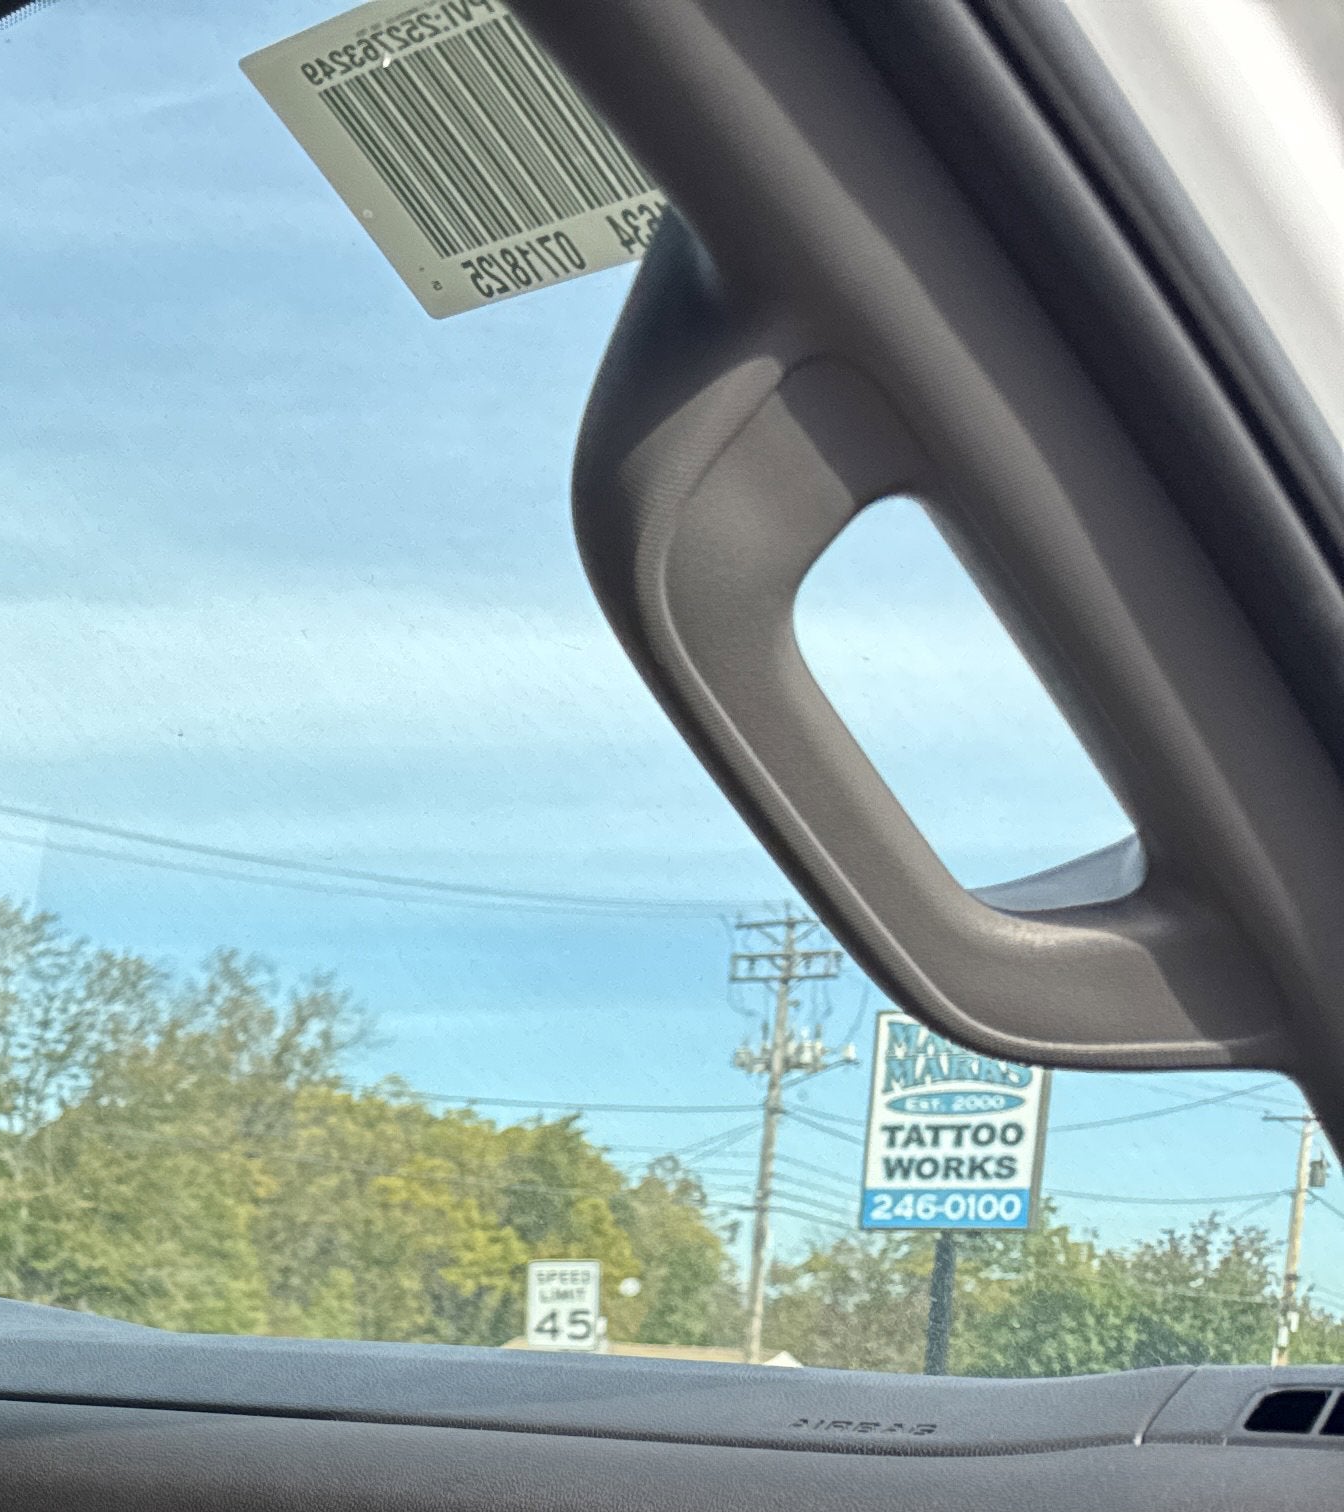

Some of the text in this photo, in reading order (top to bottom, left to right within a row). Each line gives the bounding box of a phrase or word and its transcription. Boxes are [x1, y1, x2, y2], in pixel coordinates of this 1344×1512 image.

[952, 1095, 1006, 1111] 2000
[881, 1122, 1025, 1149] TATTOO
[883, 1156, 1017, 1181] WORKS
[870, 1194, 1022, 1221] 246-0100
[536, 1270, 591, 1285] SPEED
[538, 1287, 585, 1303] LIMIT
[534, 1308, 592, 1341] 45
